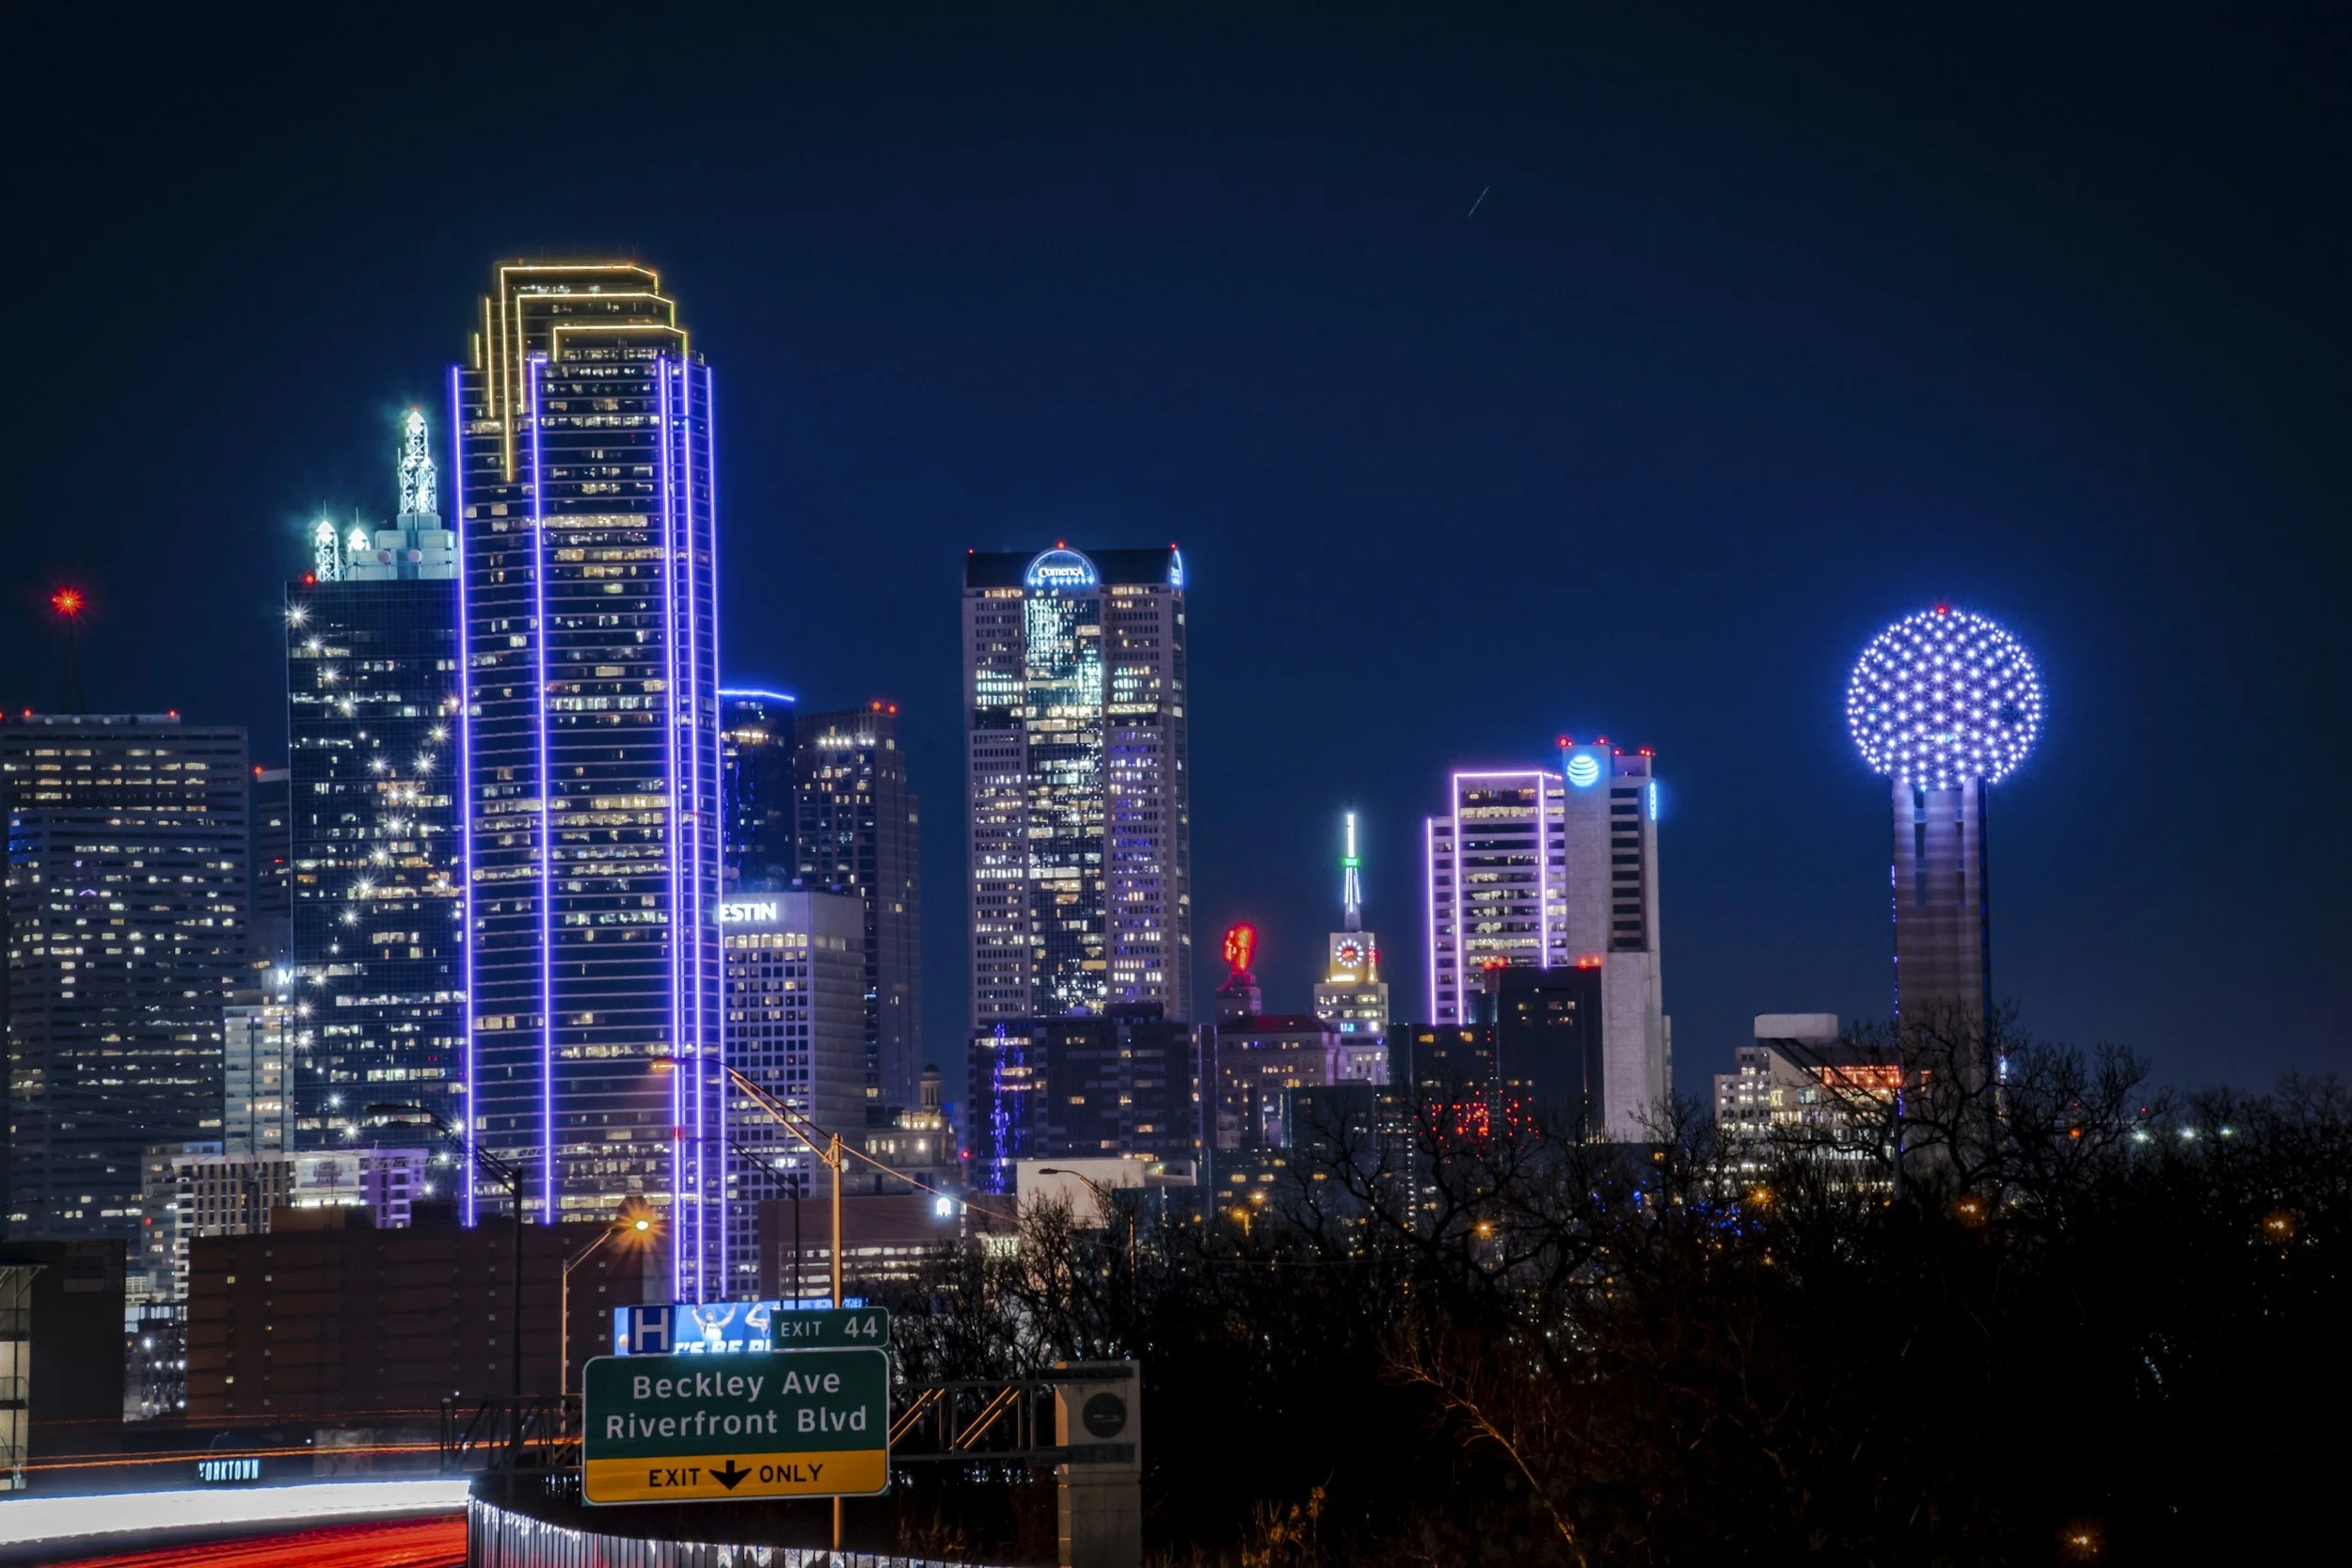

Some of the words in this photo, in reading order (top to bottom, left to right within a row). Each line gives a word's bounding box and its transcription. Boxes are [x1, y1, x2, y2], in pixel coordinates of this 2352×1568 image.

[719, 902, 777, 922] ESTIN
[634, 1307, 669, 1352] H
[780, 1321, 822, 1338] EXIT
[844, 1316, 879, 1338] 44
[632, 1371, 764, 1402] Beckley
[782, 1370, 840, 1395] Ave
[607, 1409, 778, 1440] Riverfront
[797, 1405, 866, 1433] Blvd
[199, 1459, 259, 1481] YORKTOWN
[648, 1467, 701, 1487] EXIT
[759, 1463, 823, 1483] ONLY
